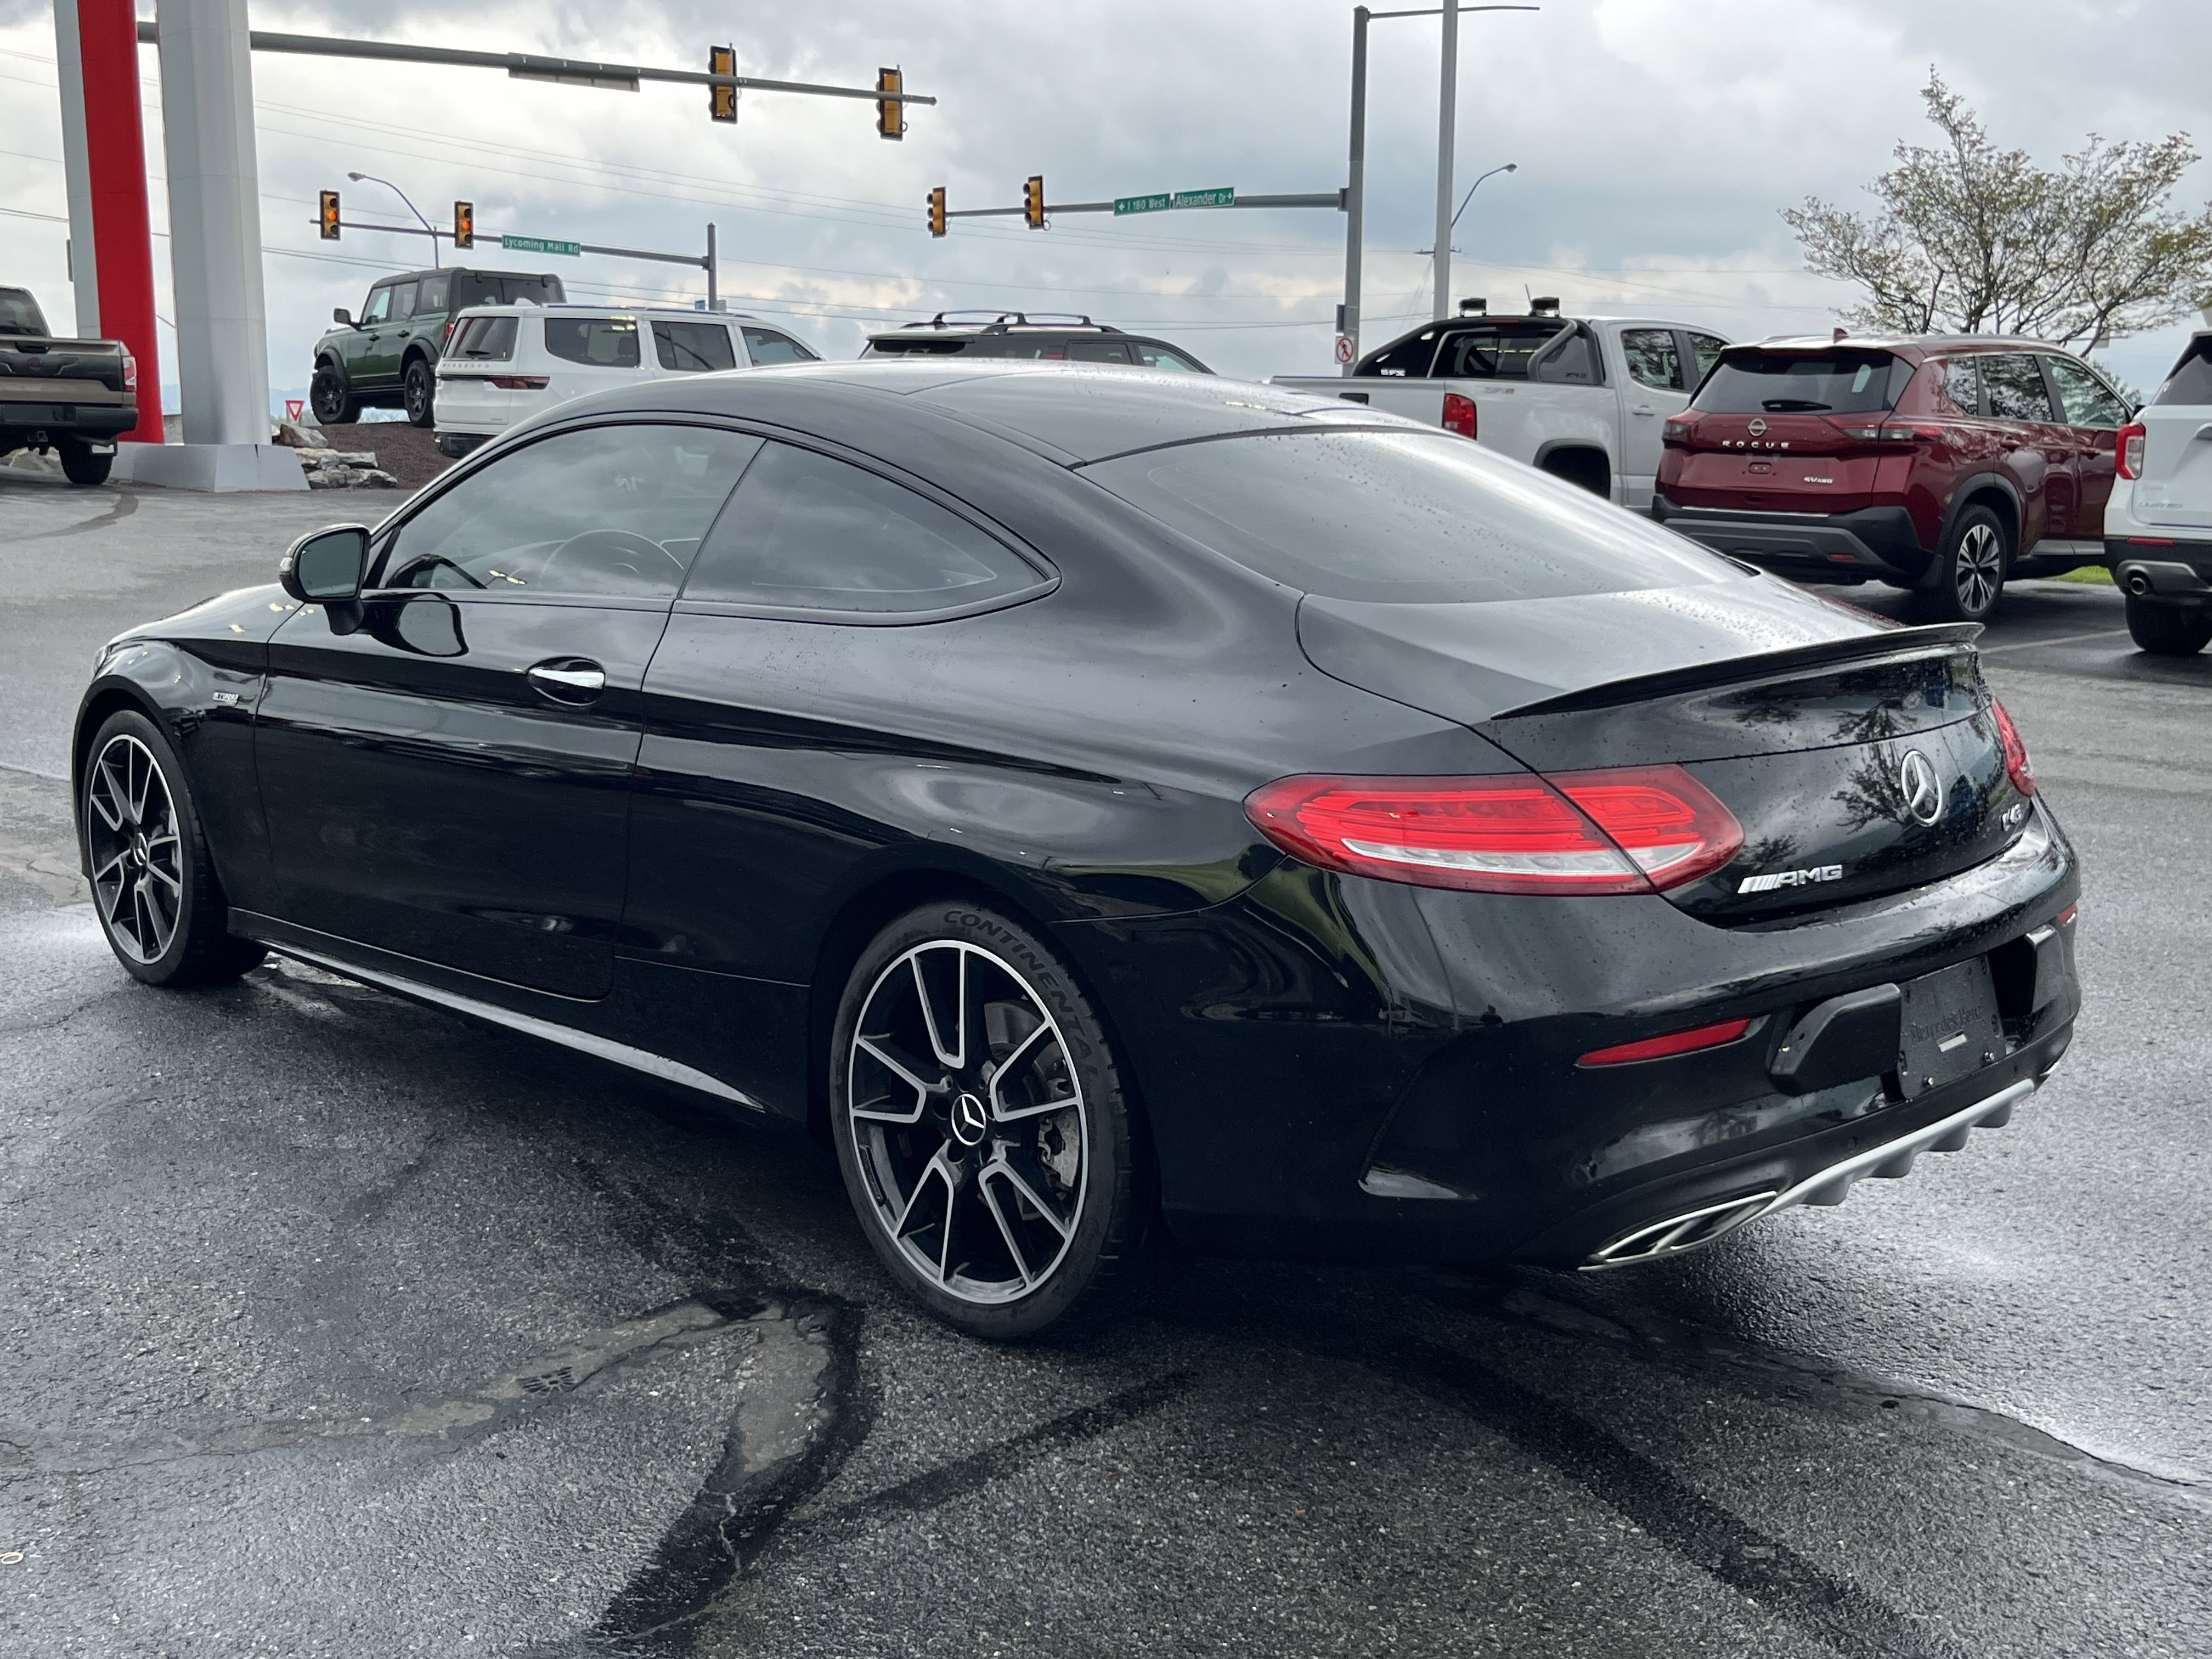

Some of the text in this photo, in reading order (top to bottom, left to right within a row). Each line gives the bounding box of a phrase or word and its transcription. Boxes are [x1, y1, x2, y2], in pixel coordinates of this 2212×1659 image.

[1133, 200, 1146, 212] 180
[1148, 198, 1166, 208] West
[1175, 192, 1216, 207] Alexander
[1218, 194, 1227, 204] Dr
[505, 238, 544, 252] Lycoming
[547, 242, 565, 252] Mall
